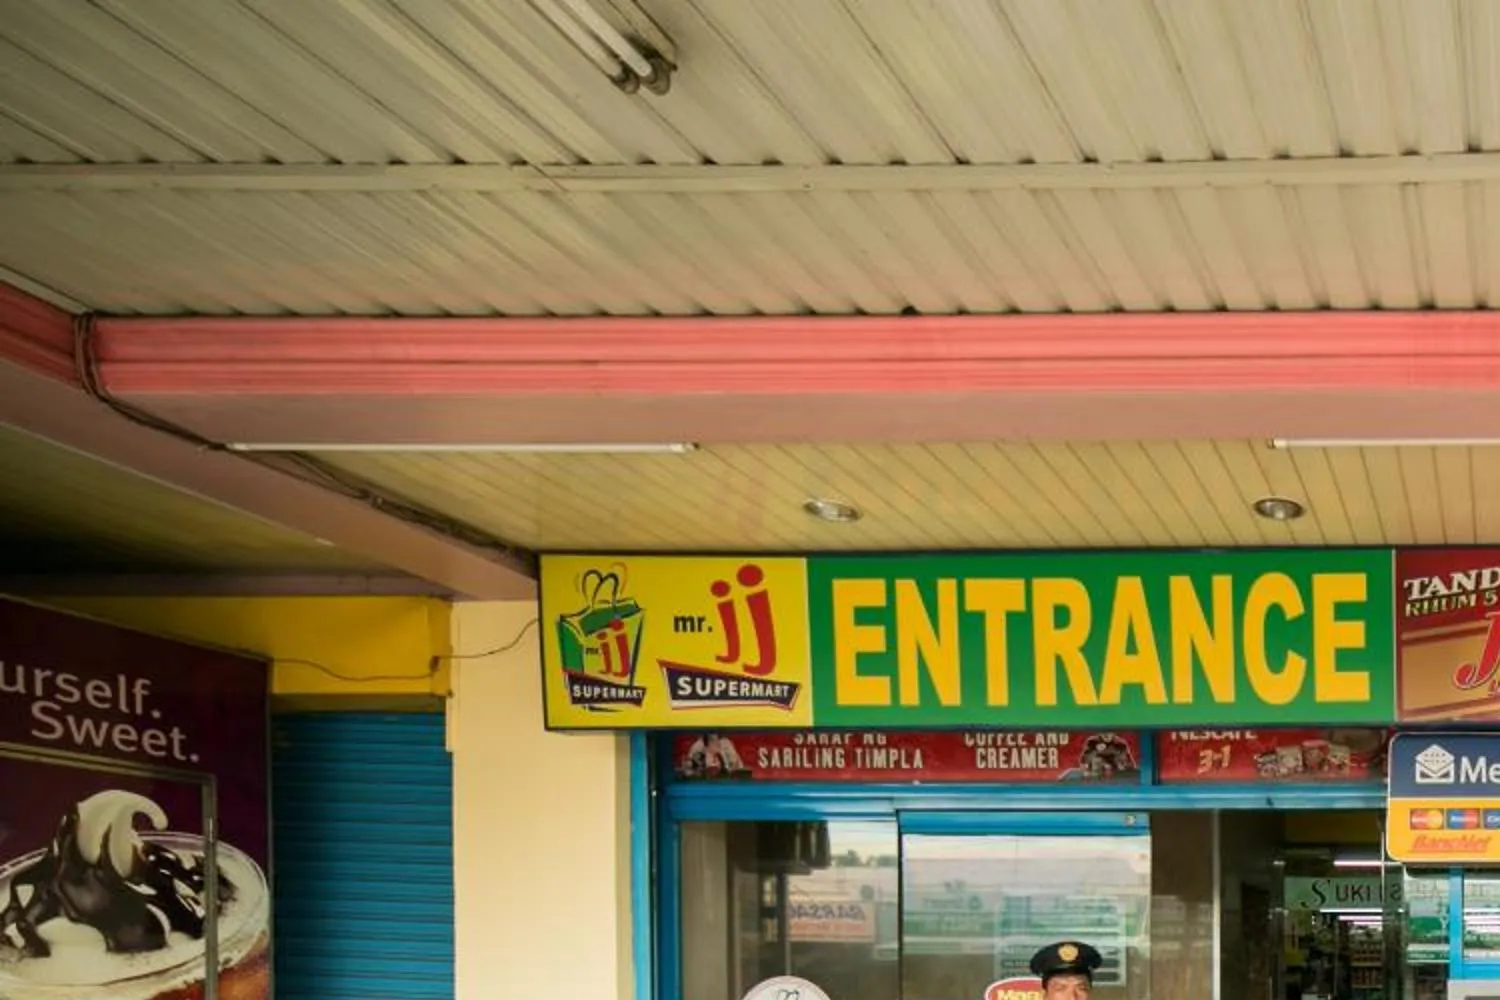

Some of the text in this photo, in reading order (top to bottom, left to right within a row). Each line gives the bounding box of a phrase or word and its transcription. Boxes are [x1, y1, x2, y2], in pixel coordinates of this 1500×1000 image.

[1405, 593, 1477, 618] RHUM
[1484, 590, 1499, 608] 5
[673, 614, 713, 633] mr.
[831, 572, 1371, 707] ENTRANCE
[573, 683, 643, 699] SUPERMART
[676, 675, 791, 699] SUPERMART
[31, 700, 200, 763] Sweet.
[975, 747, 1060, 769] CREAMER
